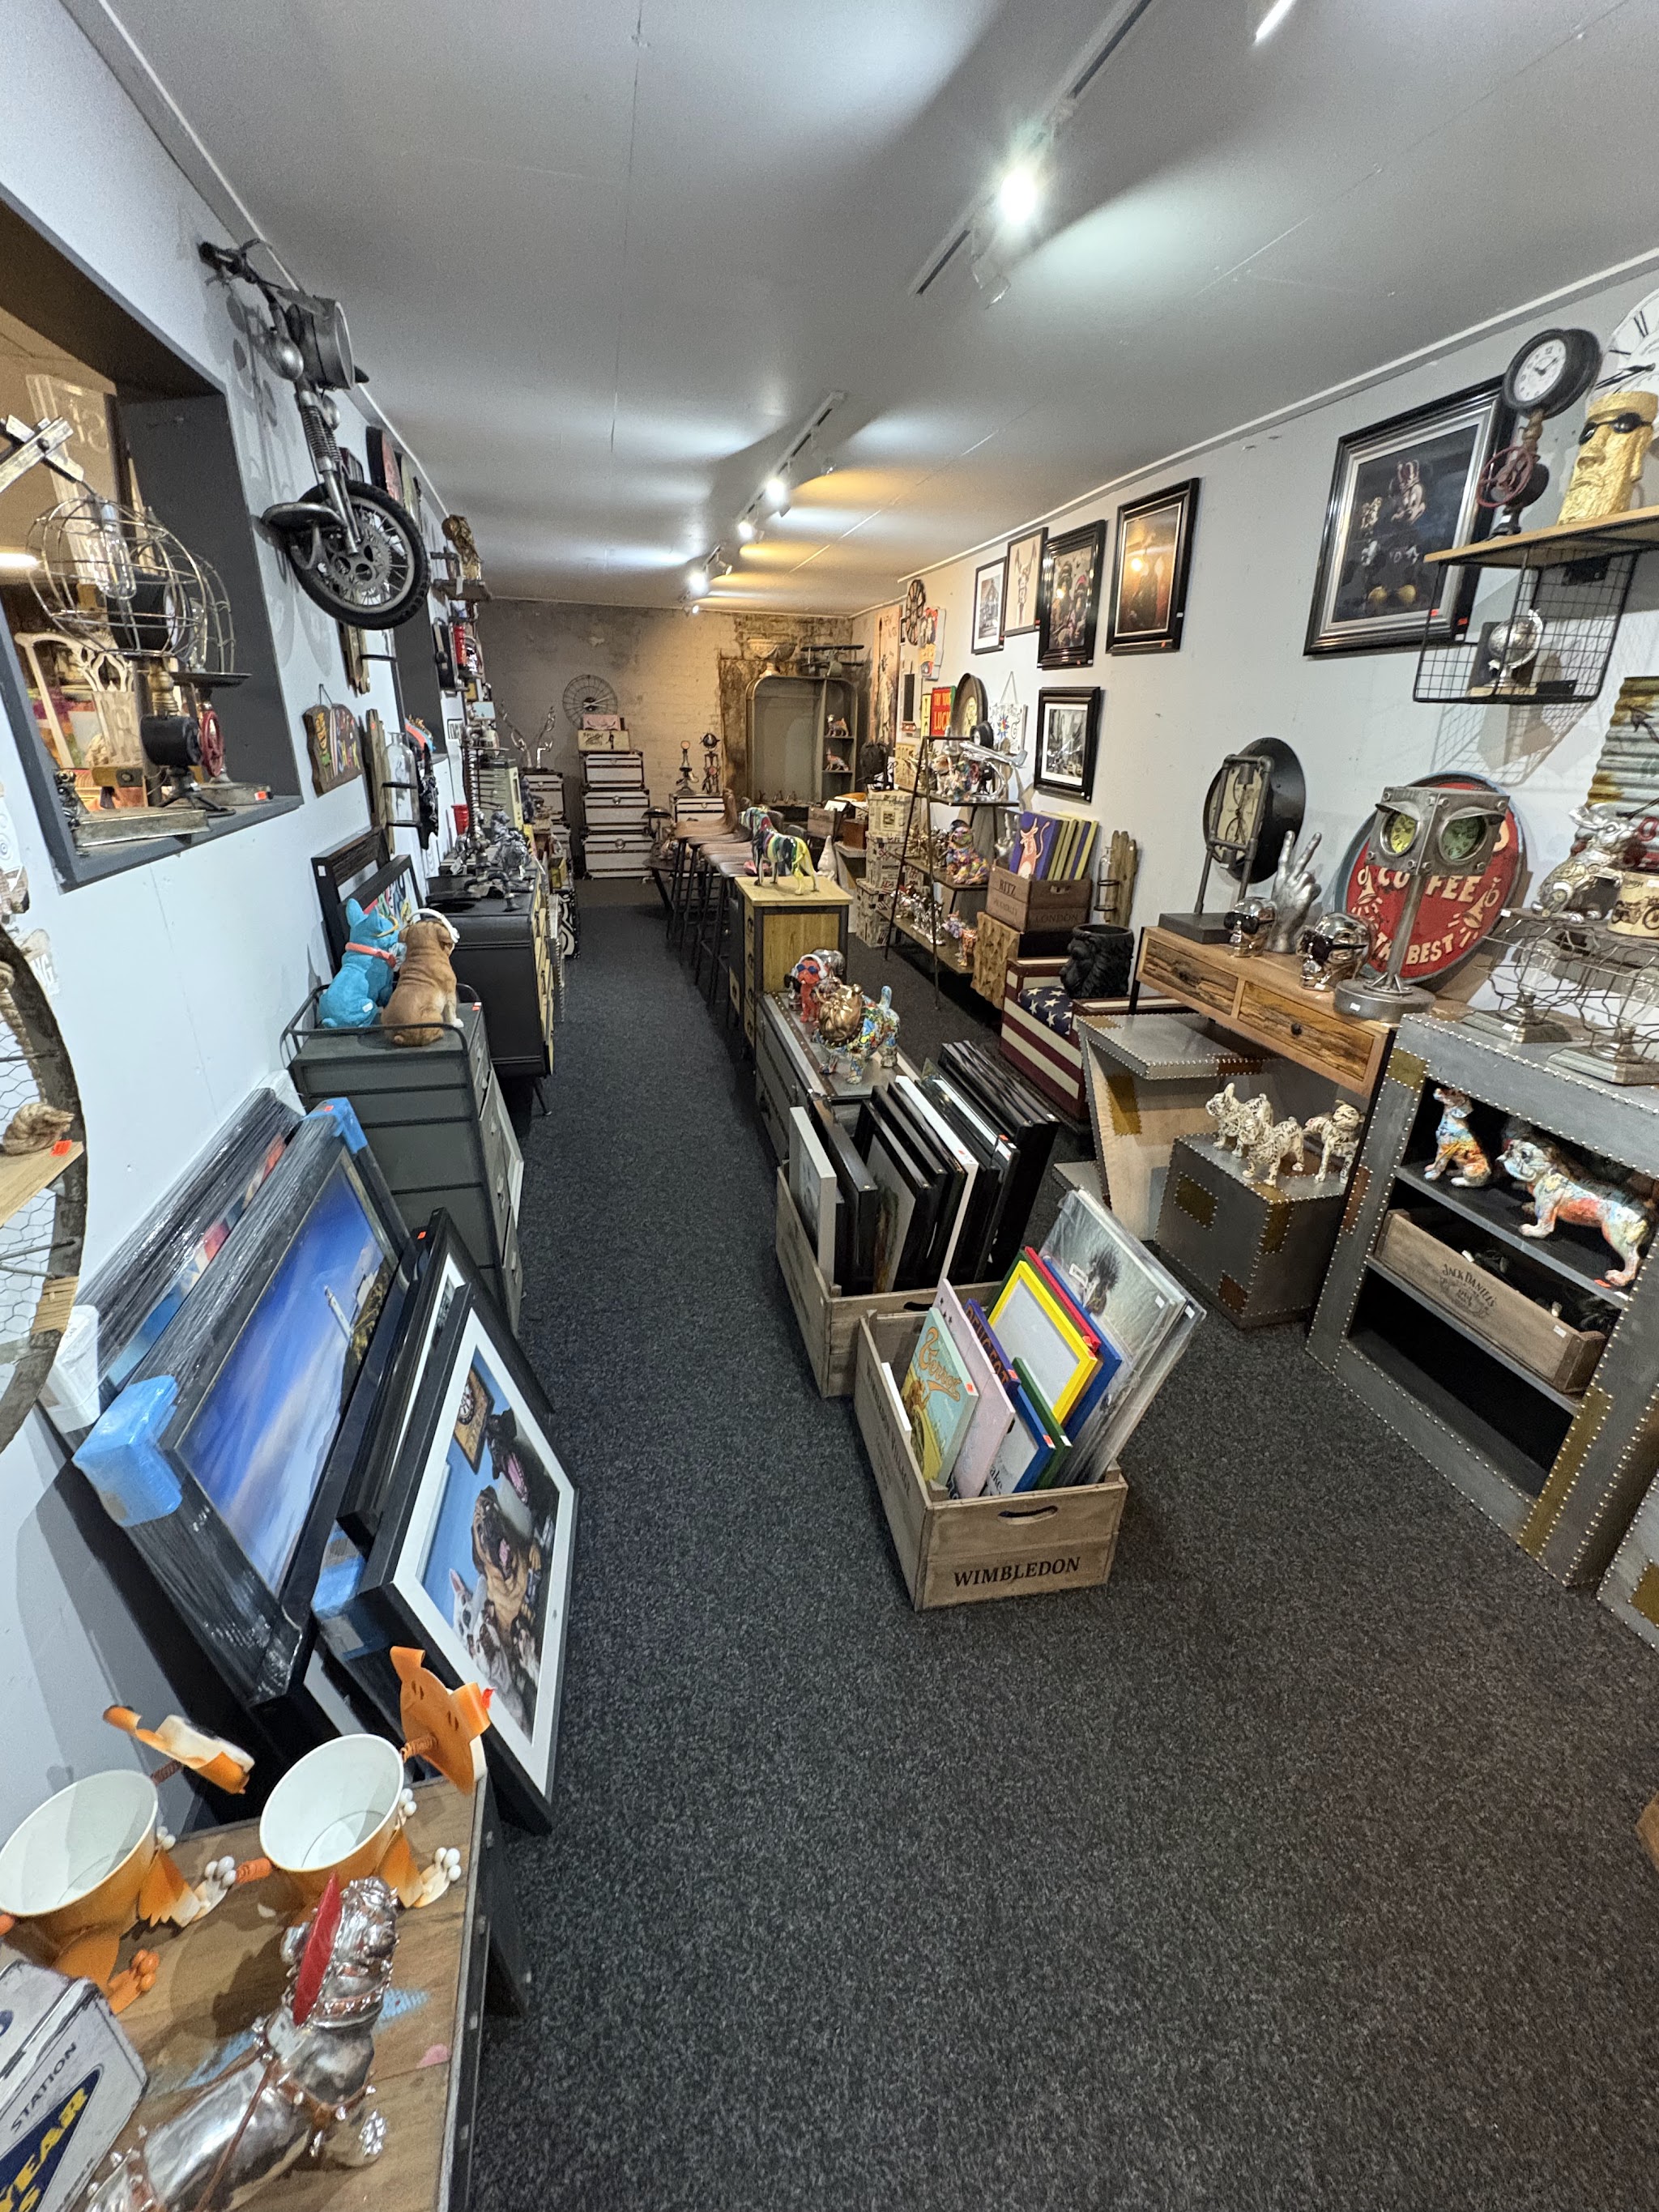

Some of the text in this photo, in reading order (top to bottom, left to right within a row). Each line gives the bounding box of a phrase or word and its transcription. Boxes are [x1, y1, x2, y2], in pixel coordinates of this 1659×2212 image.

[999, 879, 1017, 896] RITZ
[1377, 867, 1482, 903] COFEE
[1036, 912, 1079, 923] LONDON
[1405, 933, 1455, 965] BEST
[1442, 1264, 1464, 1281] JACK
[953, 1556, 1081, 1588] WIMBLEDON
[10, 2042, 78, 2134] STATION
